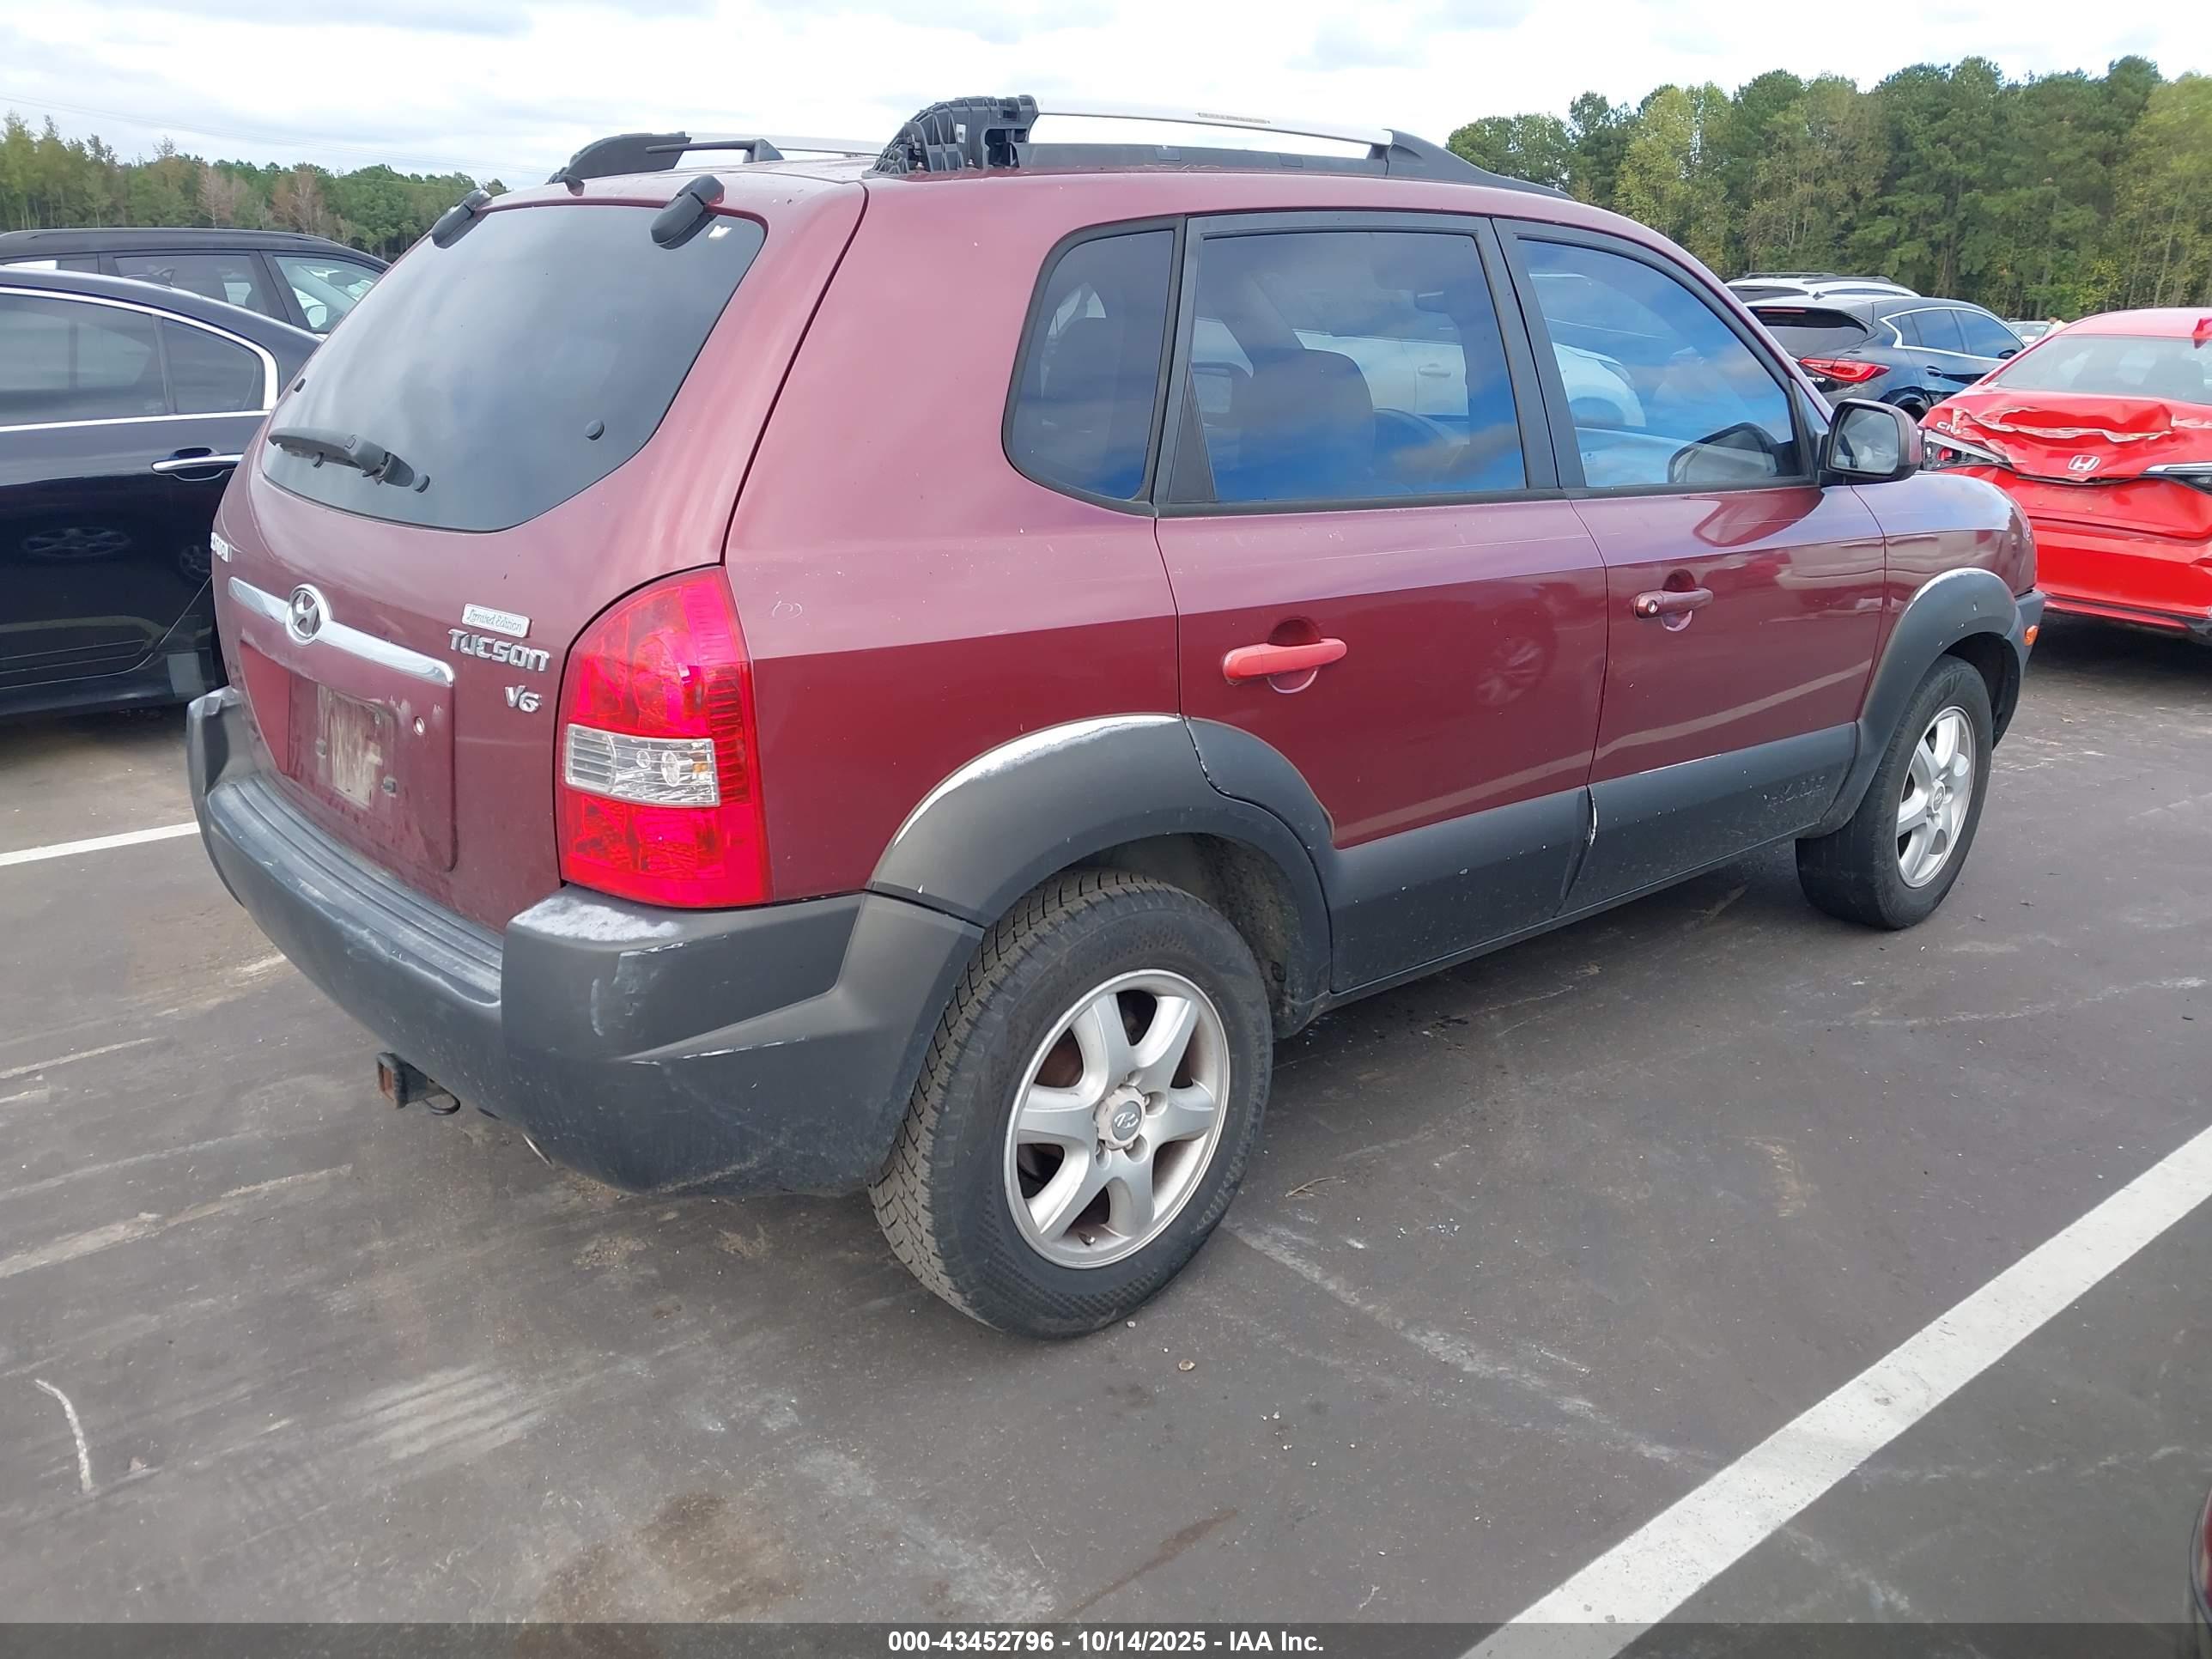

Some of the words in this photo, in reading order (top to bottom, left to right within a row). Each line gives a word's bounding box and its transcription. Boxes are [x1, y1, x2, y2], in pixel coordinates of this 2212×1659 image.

[495, 615, 522, 632] Edition
[447, 629, 550, 672] TUCSON
[505, 685, 541, 713] V6
